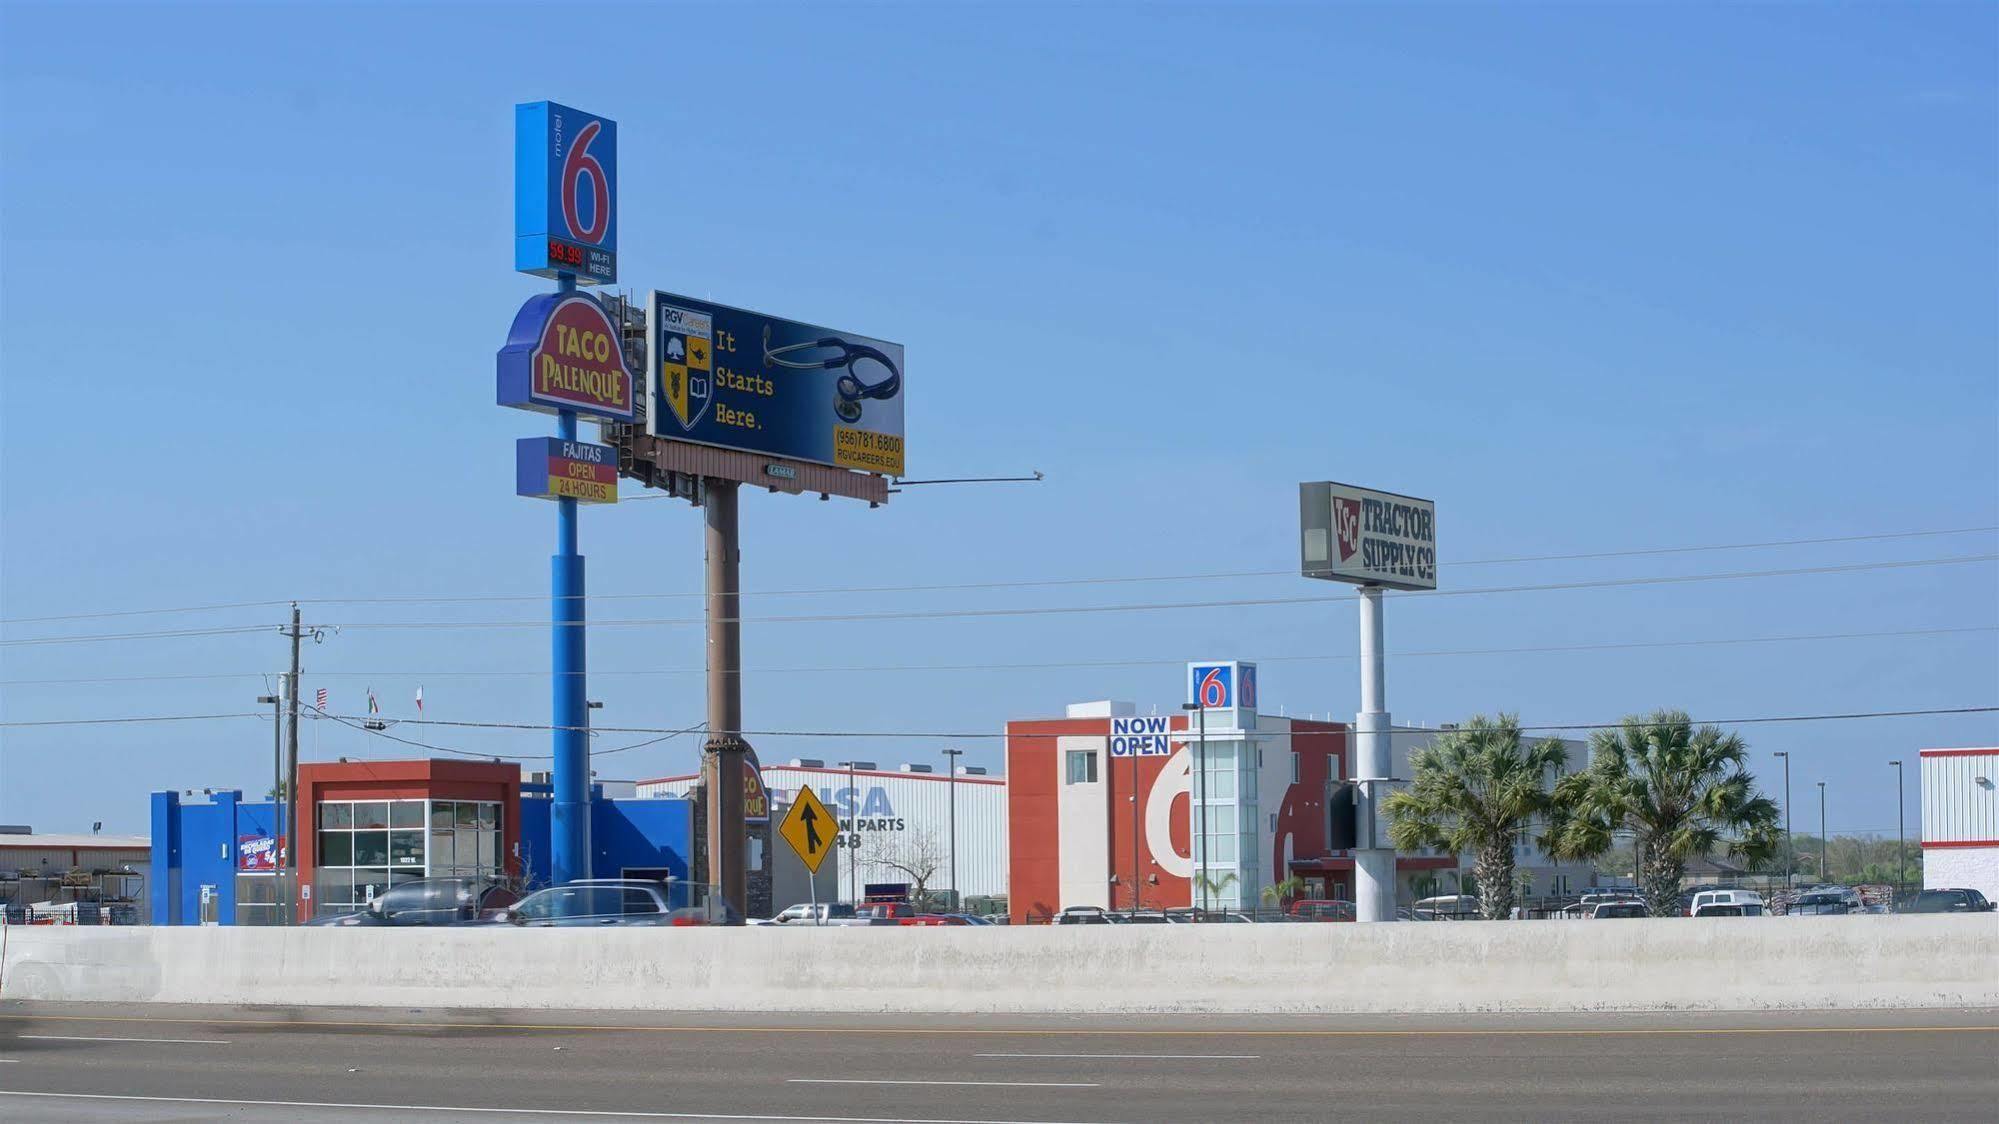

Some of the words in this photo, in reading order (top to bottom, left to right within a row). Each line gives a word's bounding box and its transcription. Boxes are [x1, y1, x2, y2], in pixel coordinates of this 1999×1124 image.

[554, 114, 563, 158] motel
[561, 120, 610, 245] 6
[589, 262, 612, 277] HERE
[590, 250, 610, 265] WI-FI
[556, 323, 610, 364] TACO
[716, 329, 737, 353] It
[542, 352, 625, 406] PALENQUE
[716, 366, 774, 397] Starts
[716, 402, 763, 430] Here.
[562, 441, 602, 463] FAJITAS
[568, 462, 596, 480] OPEN
[559, 480, 571, 494] 24
[572, 483, 607, 500] HOURS
[1335, 499, 1358, 552] TSC
[1362, 498, 1433, 542] TRACTOR
[1363, 537, 1415, 577] SUPPLY
[1200, 667, 1226, 707] 6
[1114, 717, 1167, 735] NOW
[1112, 734, 1169, 756] OPEN
[857, 818, 905, 832] PARTS
